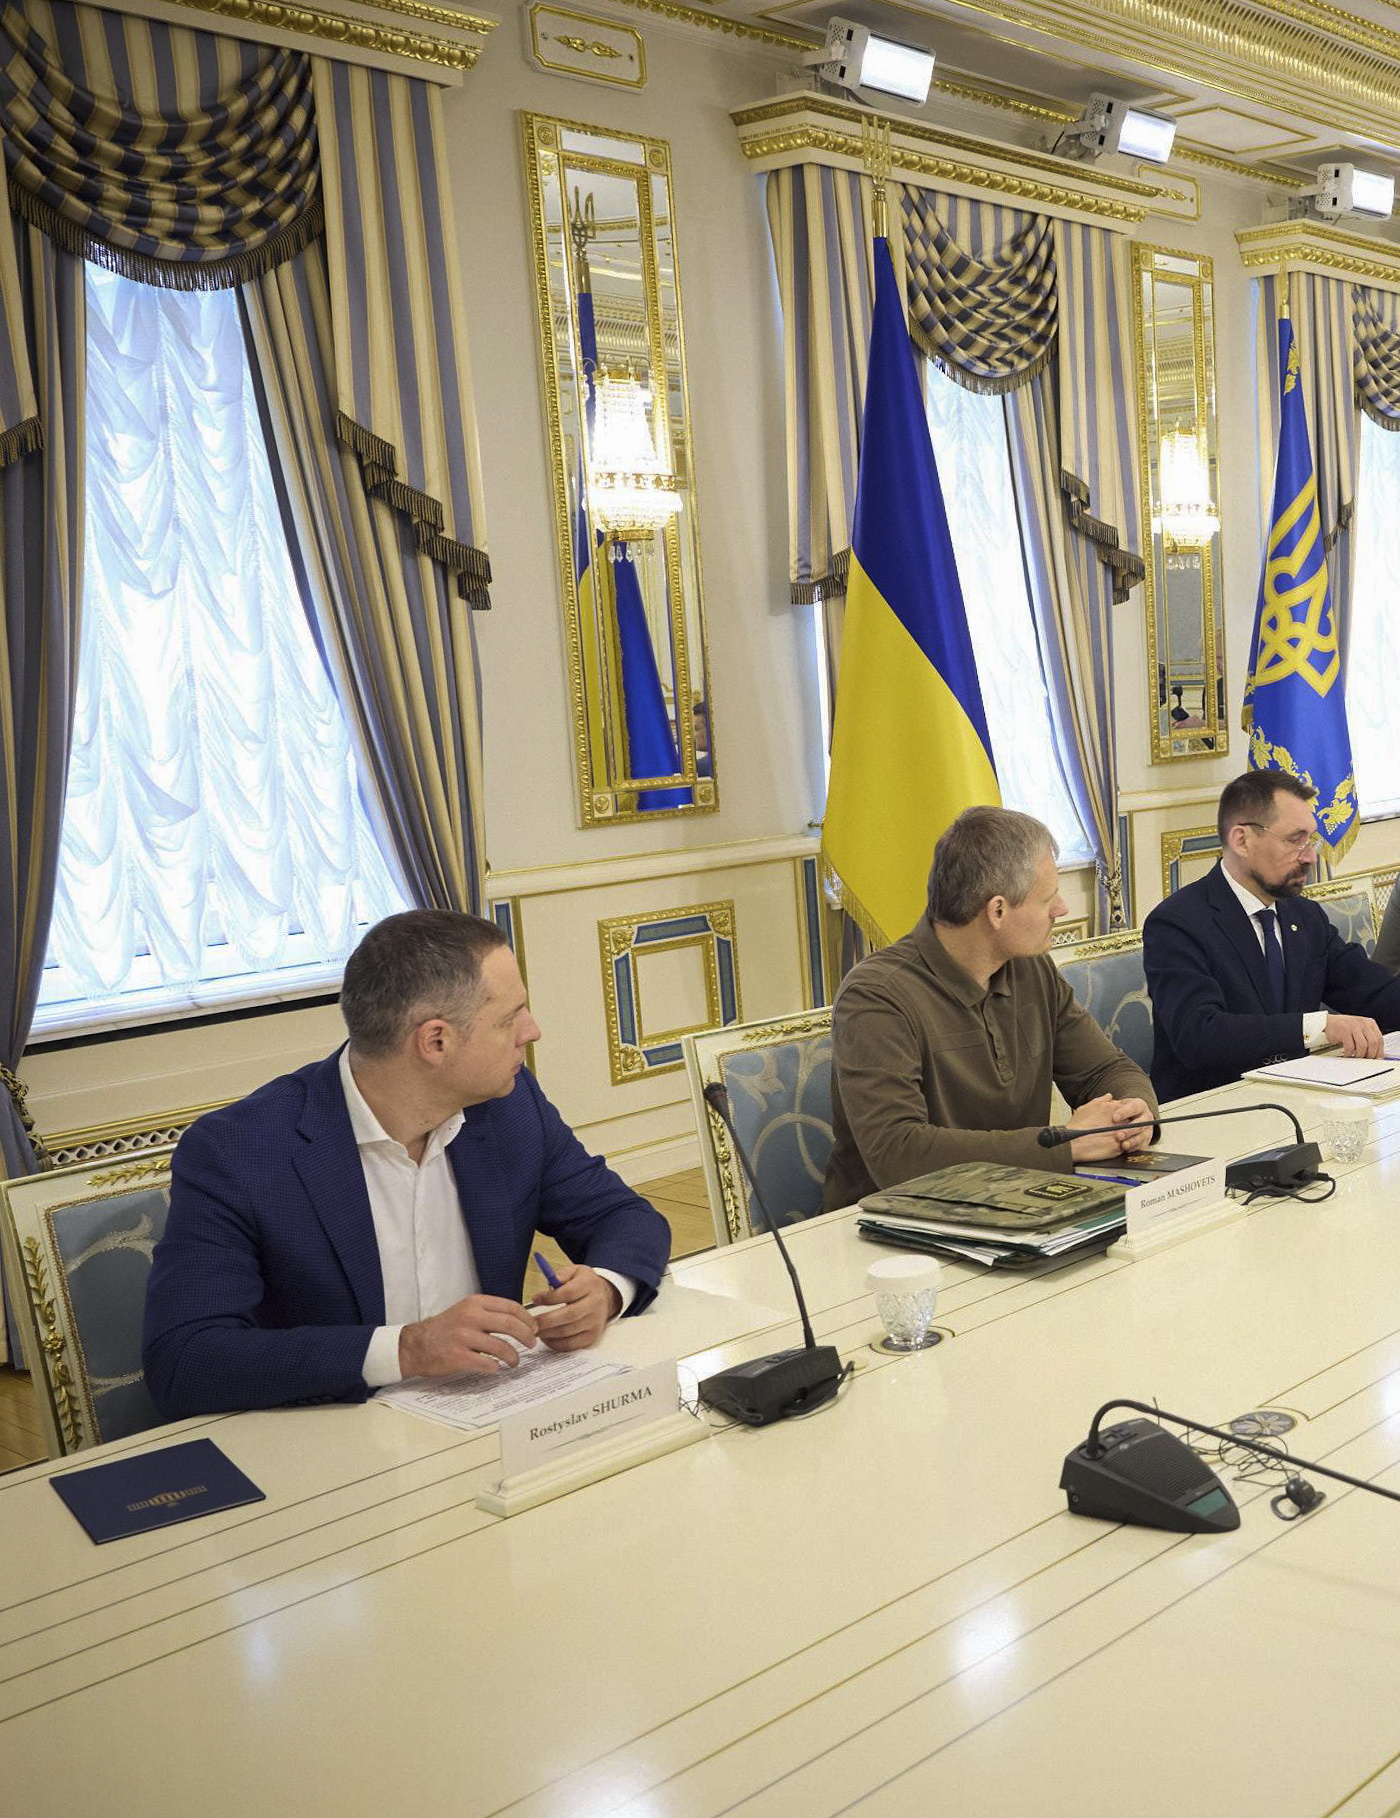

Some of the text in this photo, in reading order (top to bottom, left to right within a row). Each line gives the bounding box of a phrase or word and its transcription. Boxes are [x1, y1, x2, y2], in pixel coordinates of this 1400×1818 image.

[1140, 1175, 1216, 1209] Roman MASHOVETS
[529, 1386, 653, 1441] Rostyslav SHURMA
